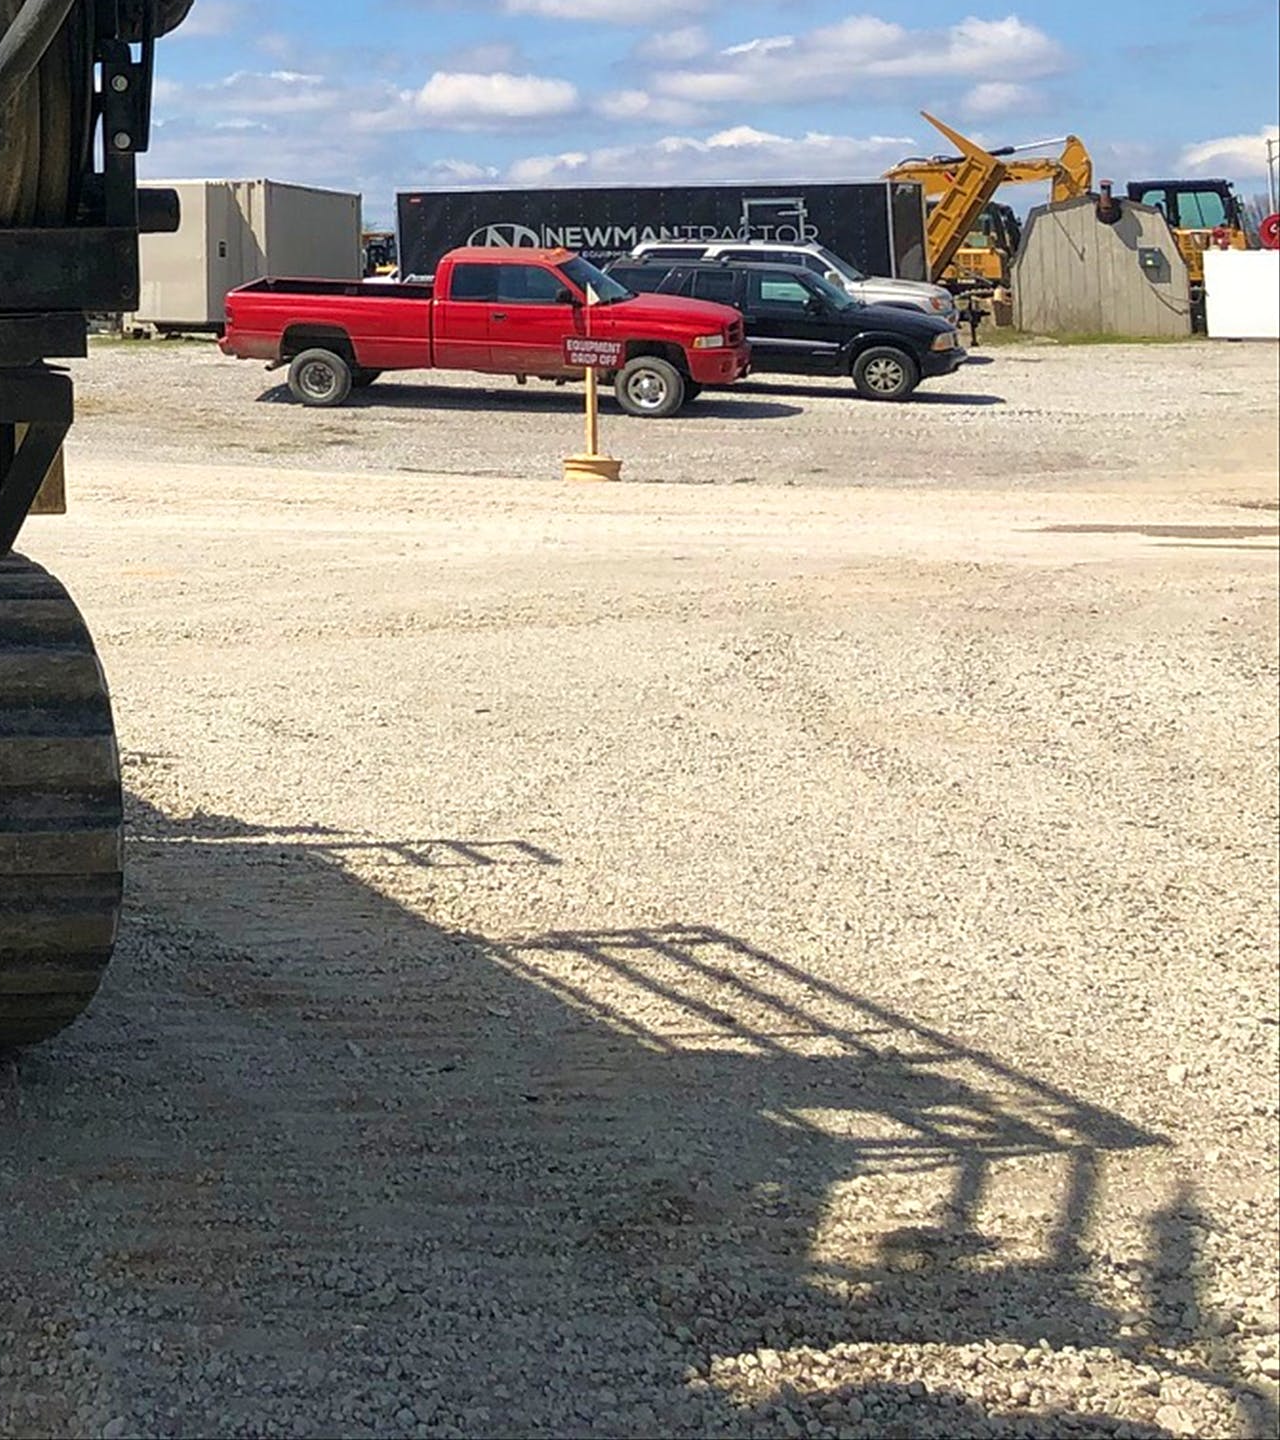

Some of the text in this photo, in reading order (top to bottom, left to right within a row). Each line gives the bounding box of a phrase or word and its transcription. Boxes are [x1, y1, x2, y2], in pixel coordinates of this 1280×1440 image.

[566, 340, 621, 354] EQUIPMENT
[571, 352, 617, 366] DROP OFF
